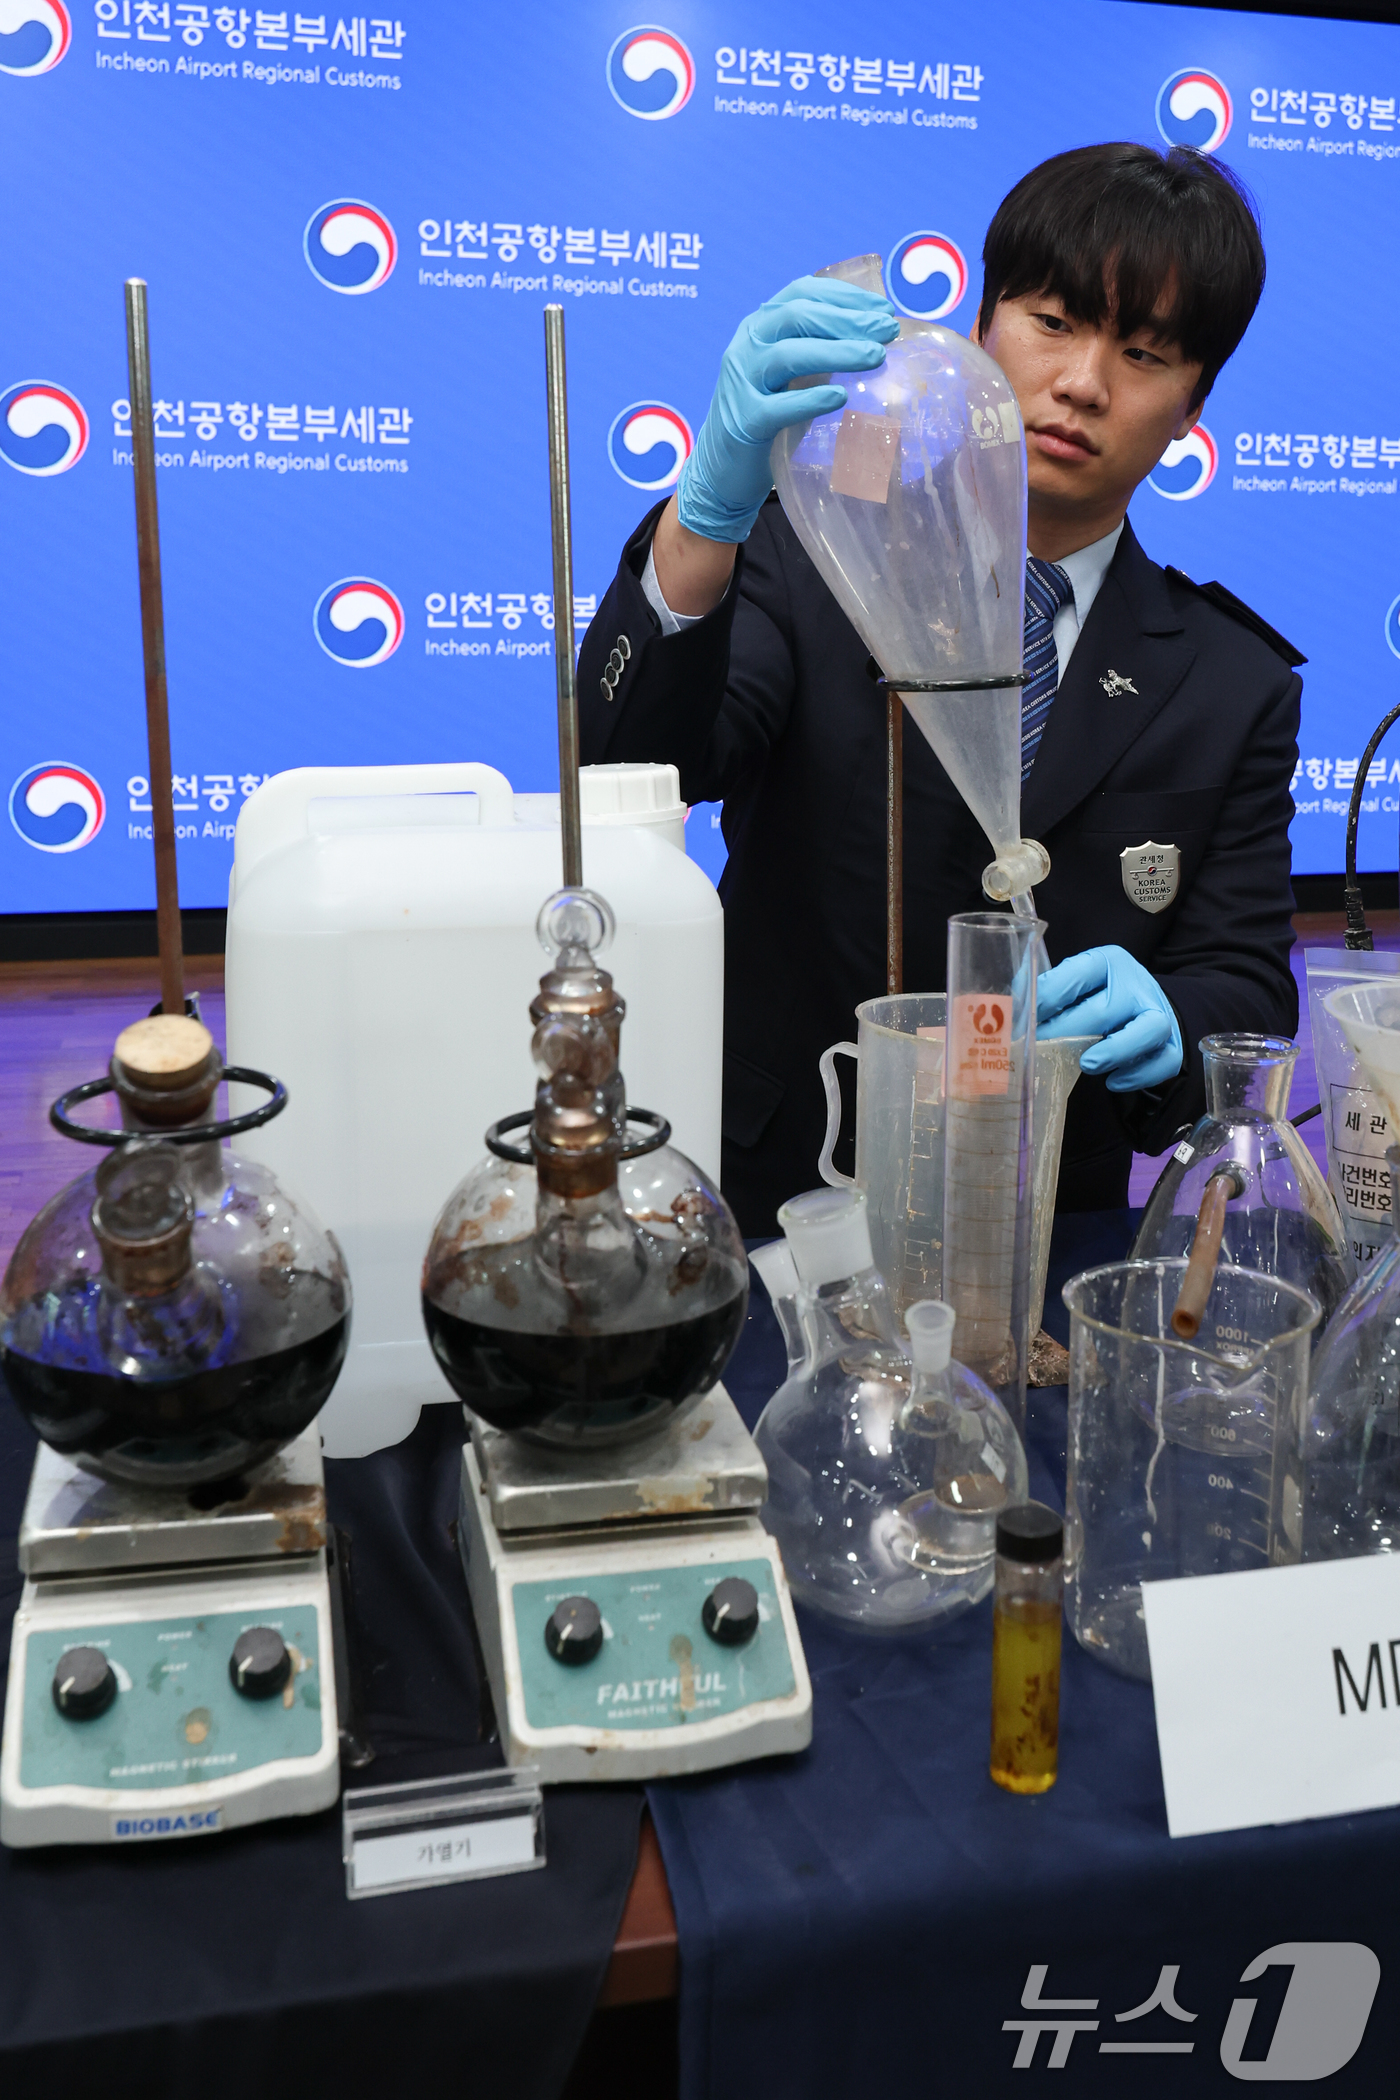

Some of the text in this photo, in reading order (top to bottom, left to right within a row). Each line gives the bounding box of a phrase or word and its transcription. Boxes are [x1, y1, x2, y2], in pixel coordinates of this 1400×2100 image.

[94, 0, 406, 59] 인천공항본부세관
[96, 50, 402, 90] Incheon Airport Regional Customs
[715, 46, 984, 101] 인천공항본부세관
[714, 95, 978, 130] Incheon Airport Regional Customs
[1250, 87, 1400, 132] 인천공항본
[1248, 132, 1303, 152] Incheon
[1306, 137, 1354, 157] Airport
[418, 218, 703, 270] 인천공항본부세관
[419, 268, 698, 299] Incheon Airport Regional Customs
[189, 450, 250, 472] Airport
[254, 452, 330, 474] Regional
[334, 453, 408, 473] Customs
[1232, 474, 1397, 497] Incheon Airport Regional
[425, 638, 491, 656] Incheon
[495, 639, 552, 660] Airport
[1140, 855, 1164, 864] 관세청
[1134, 886, 1171, 895] CUSTOMS
[1138, 879, 1166, 887] KOREA
[1343, 1185, 1392, 1213] 리번호
[597, 1671, 727, 1706] FAITHUL
[116, 1809, 222, 1836] BIOBASE
[417, 1837, 472, 1865] 가열기
